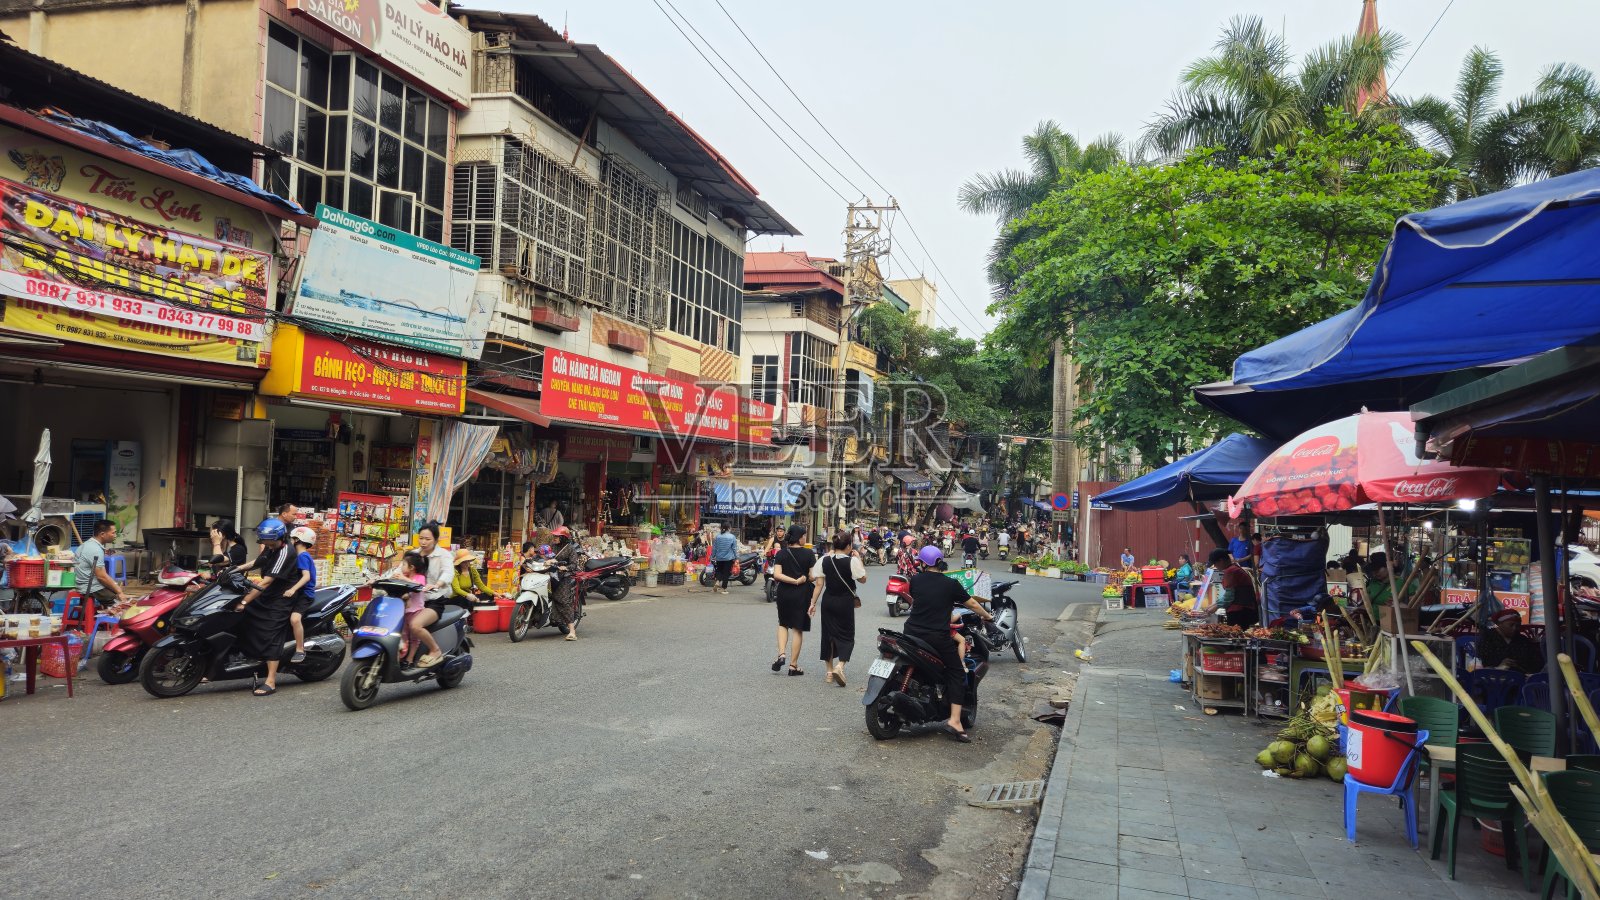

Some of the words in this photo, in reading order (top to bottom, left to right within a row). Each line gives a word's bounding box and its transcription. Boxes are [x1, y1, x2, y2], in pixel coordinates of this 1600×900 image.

[308, 0, 362, 39] SAIGON
[385, 3, 407, 30] ĐẠI
[409, 17, 424, 39] LÝ
[425, 30, 451, 57] HẢO
[452, 48, 468, 70] HÀ
[139, 187, 204, 223] Linh
[23, 199, 95, 242] ĐẠI
[105, 224, 146, 253] LÝ
[153, 236, 222, 272] HẠT
[322, 207, 396, 242] DaNangGo.com
[26, 279, 70, 301] 0987
[76, 290, 106, 309] 931
[112, 298, 142, 316] 933
[157, 307, 194, 326] 0343
[198, 315, 216, 332] 77
[217, 318, 235, 335] 99
[236, 320, 253, 336] 88
[313, 350, 343, 380] BÁNH
[344, 361, 367, 389] KẸO
[552, 351, 568, 375] CỬA
[569, 357, 589, 381] HÀNG
[589, 363, 599, 382] BÀ
[599, 367, 622, 387] NGOAN
[707, 394, 724, 411] HÀNG
[1292, 443, 1337, 459] Coca-Cola
[1393, 477, 1460, 499] Coca-Cola
